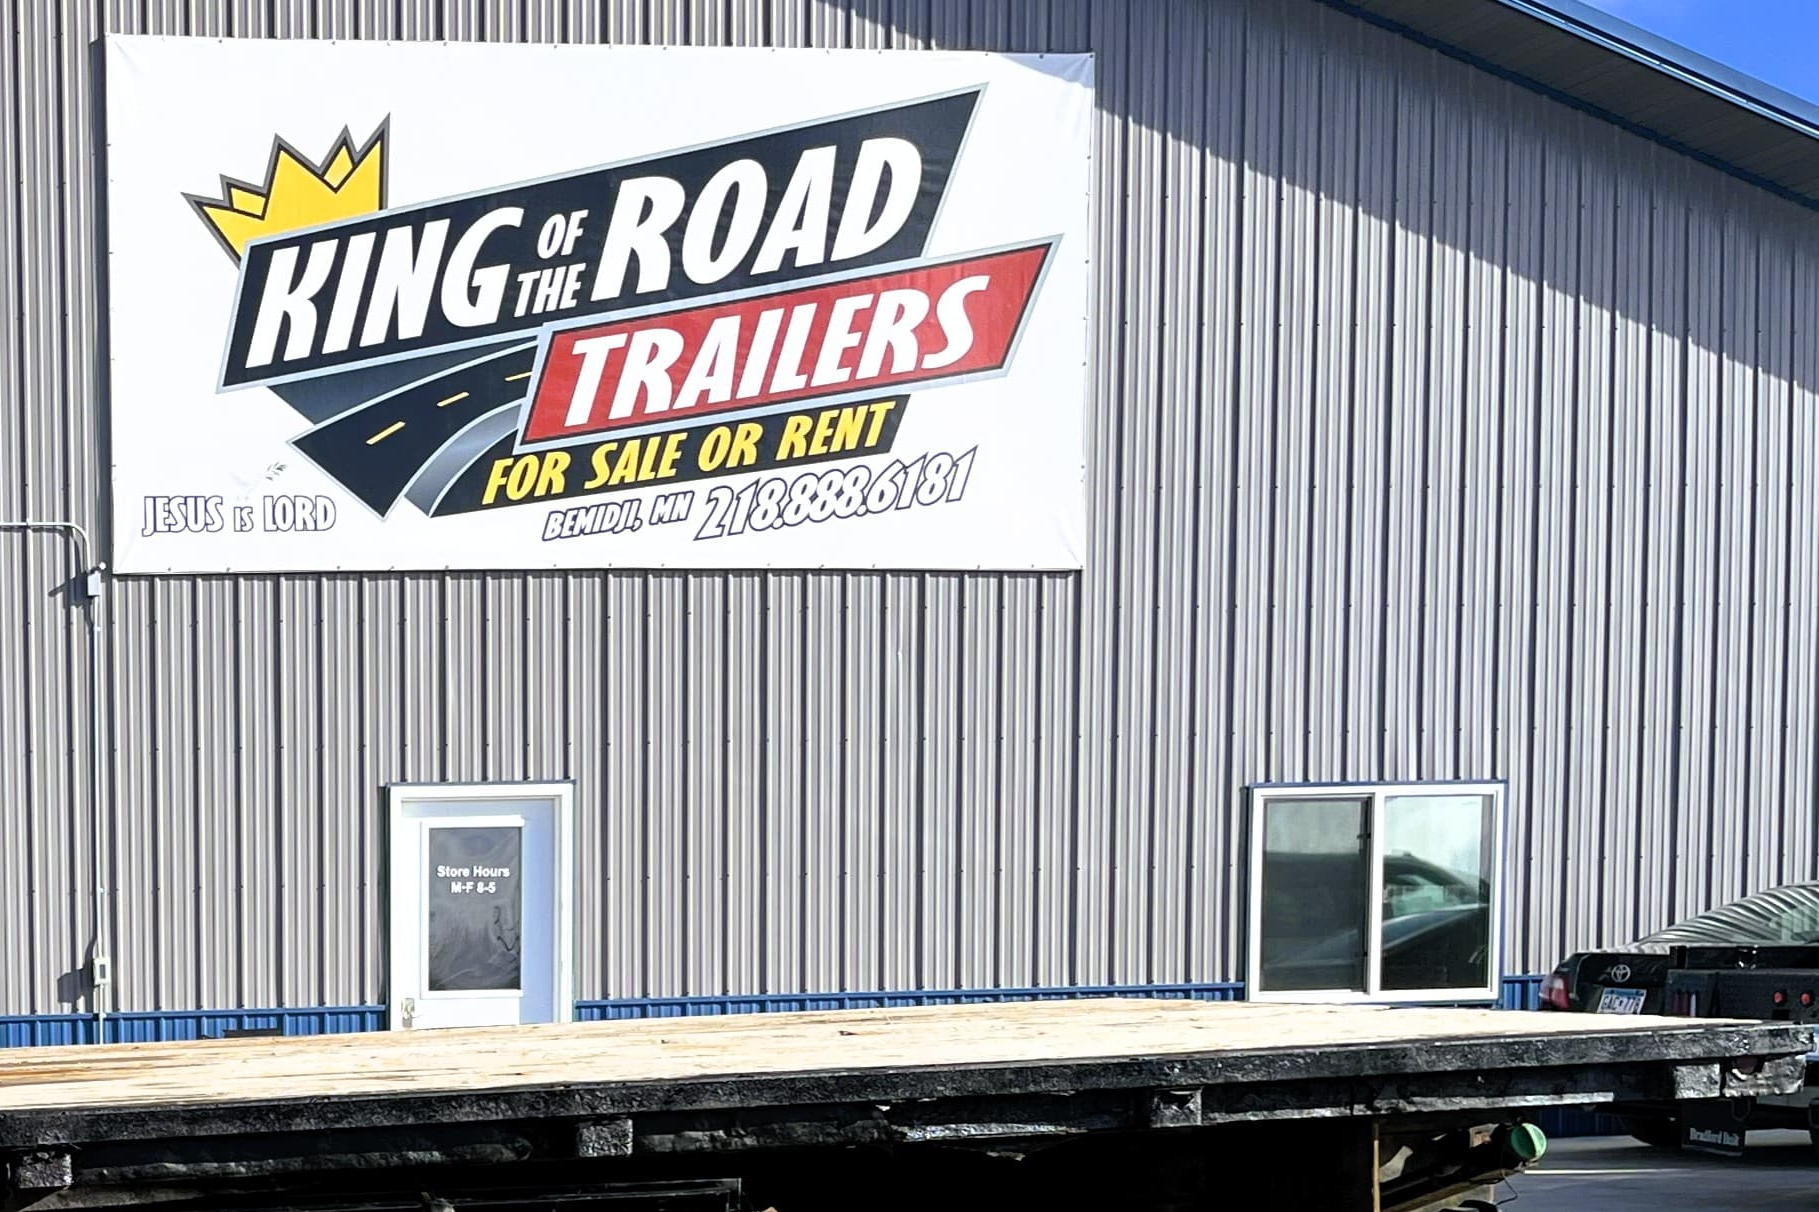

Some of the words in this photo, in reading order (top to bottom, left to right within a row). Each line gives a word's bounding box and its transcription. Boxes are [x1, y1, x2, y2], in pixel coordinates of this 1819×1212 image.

[537, 210, 589, 259] OF
[590, 137, 923, 301] ROAD
[245, 207, 525, 369] KING
[514, 262, 586, 317] THE
[563, 275, 990, 427] TRAILERS
[482, 451, 572, 505] FOR
[584, 432, 685, 489] SALE
[697, 422, 764, 472] OR
[775, 401, 896, 460] RENT
[141, 495, 224, 537] JESUS
[234, 506, 254, 532] IS
[263, 495, 336, 532] LORD
[542, 498, 642, 541] BEMIDJI,
[648, 490, 694, 526] MN
[693, 445, 978, 541] 218.888.6181
[437, 865, 470, 877] Store
[473, 865, 510, 877] Hours
[451, 882, 474, 893] M-F
